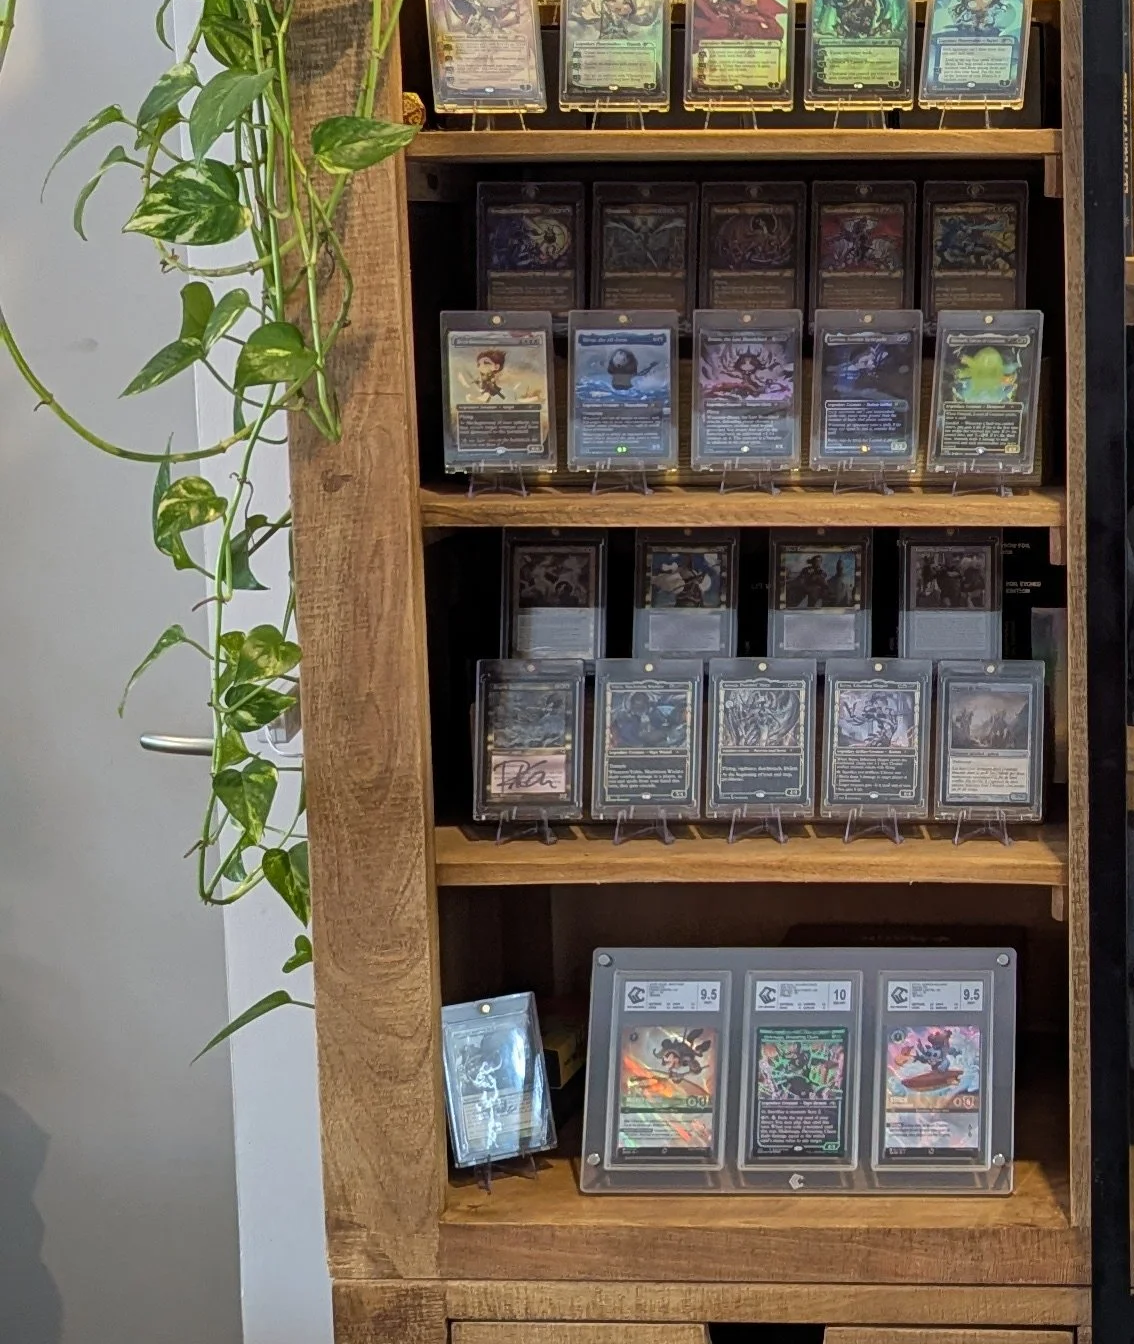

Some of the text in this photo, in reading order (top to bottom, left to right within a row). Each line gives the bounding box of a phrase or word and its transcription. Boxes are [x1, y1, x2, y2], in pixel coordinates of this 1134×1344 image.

[701, 989, 717, 1000] 9.5
[834, 989, 846, 1000] 10
[963, 989, 980, 1000] 9.5
